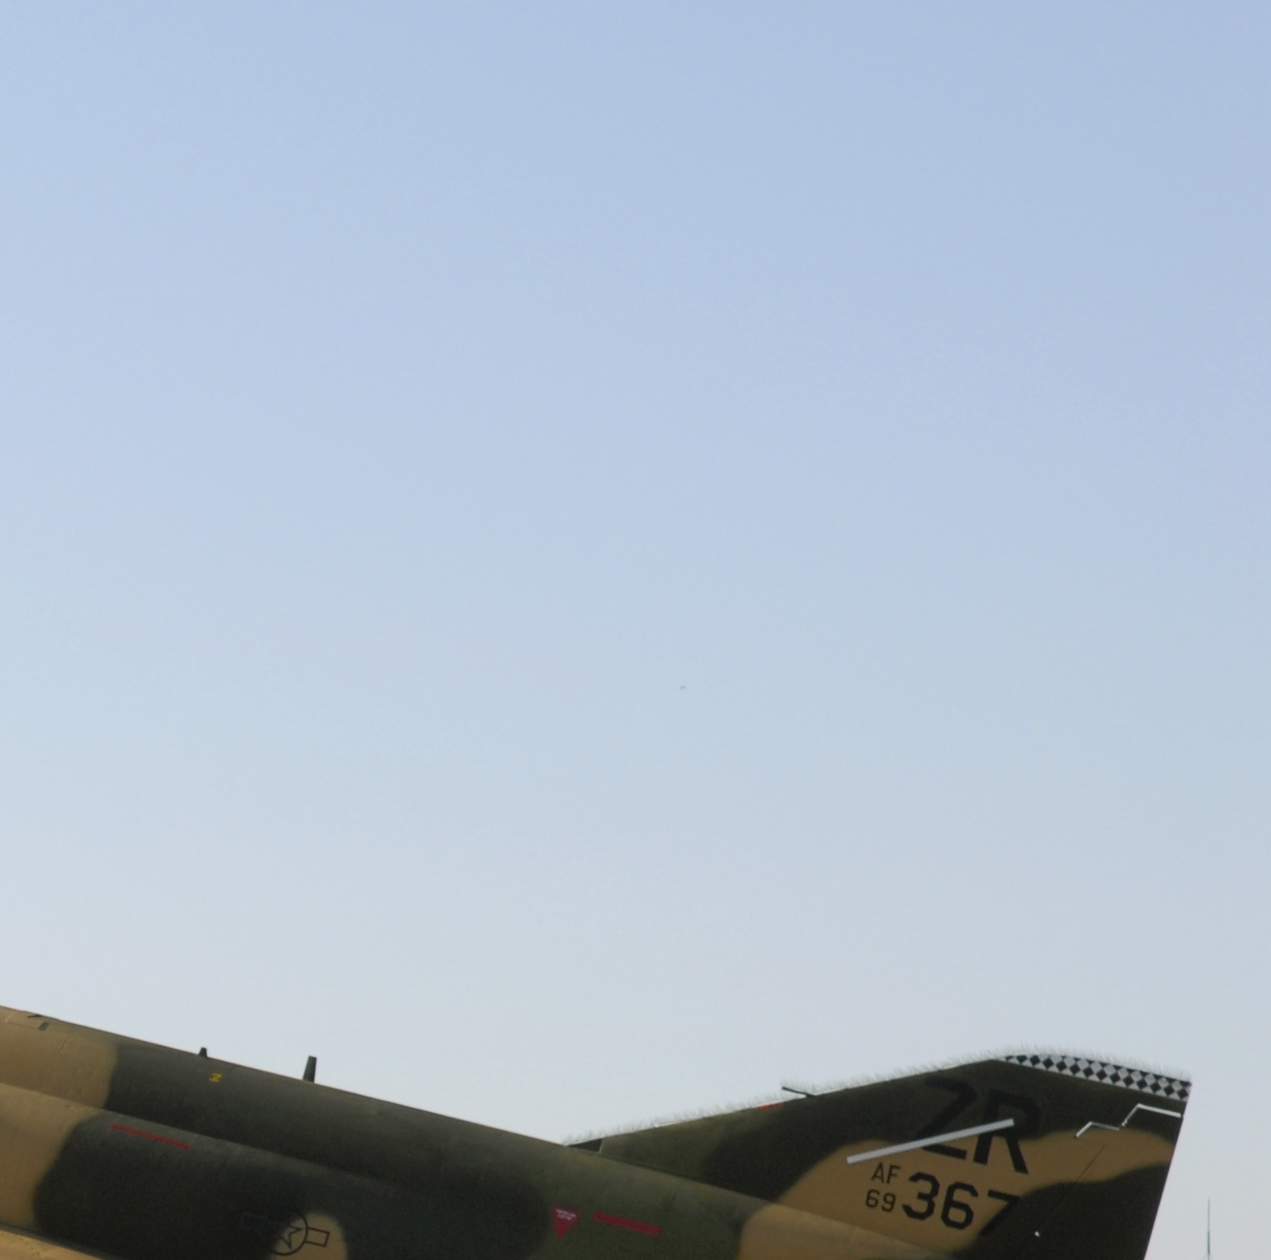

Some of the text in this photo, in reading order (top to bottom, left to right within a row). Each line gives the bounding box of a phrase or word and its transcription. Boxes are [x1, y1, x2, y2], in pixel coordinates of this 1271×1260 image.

[871, 1162, 901, 1184] AF
[865, 1189, 897, 1212] 69
[902, 1171, 1021, 1236] 367
